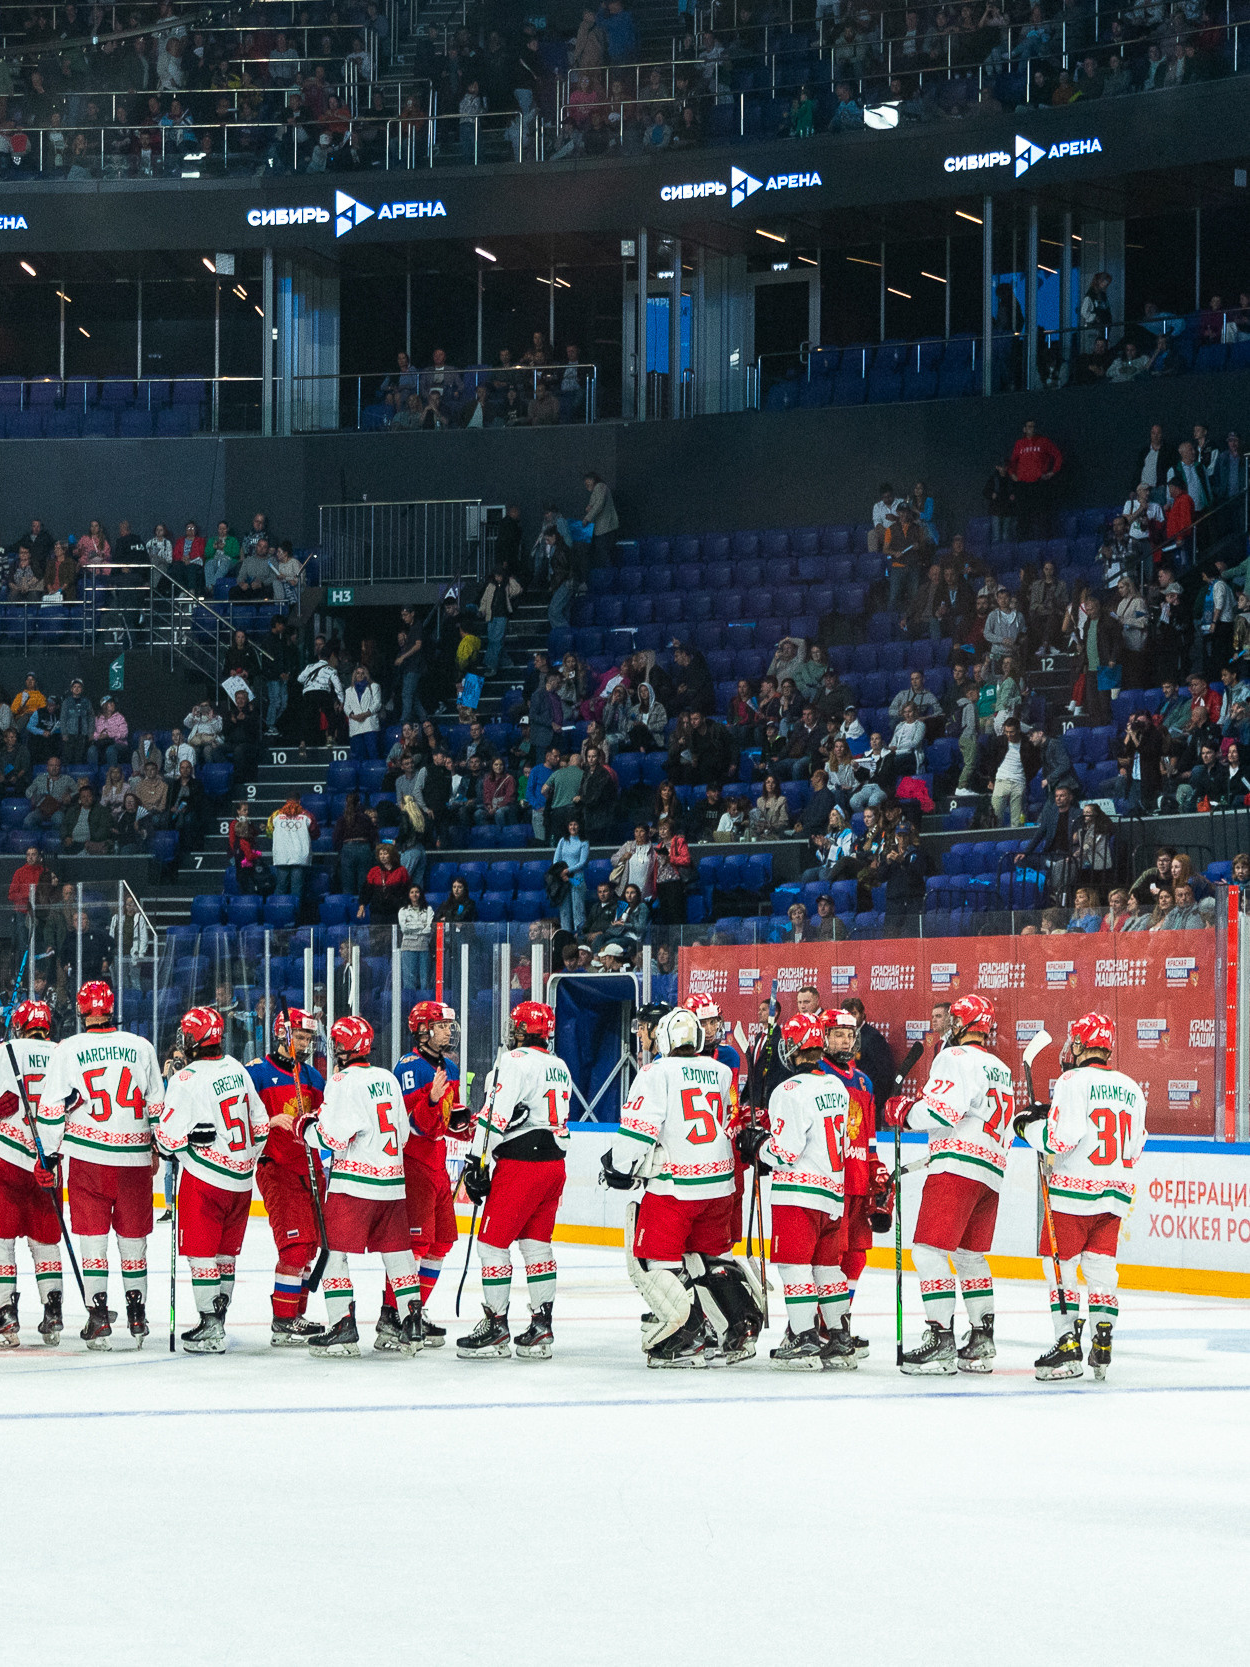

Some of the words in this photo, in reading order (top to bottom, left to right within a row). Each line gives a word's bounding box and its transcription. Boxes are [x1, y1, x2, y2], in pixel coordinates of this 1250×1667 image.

[943, 151, 1011, 173] СИБИРЬ
[1048, 138, 1102, 159] АРЕНА
[660, 181, 727, 201] СИБИРЬ
[765, 171, 822, 191] АРЕНА
[247, 207, 330, 226] СИБИРЬ
[377, 201, 447, 219] АРЕНА
[332, 590, 352, 602] H3
[1040, 658, 1054, 671] 12
[272, 752, 287, 764] 10
[332, 751, 348, 762] 10
[246, 785, 257, 797] 9
[219, 822, 229, 835] 8
[195, 856, 204, 868] 7
[981, 1013, 991, 1022] 27
[810, 1028, 821, 1037] 13
[1099, 1029, 1110, 1037] 30
[28, 1054, 50, 1068] NEV
[77, 1046, 137, 1067] MARCHENKO
[82, 1066, 146, 1122] 54
[931, 1079, 955, 1095] 27
[219, 1092, 255, 1152] 51
[680, 1087, 724, 1146] 50
[983, 1088, 1014, 1144] 27
[376, 1102, 399, 1157] 5
[1088, 1108, 1134, 1169] 30
[1149, 1178, 1250, 1212] ФЕДЕРАЦИ
[1149, 1213, 1221, 1242] ХОККЕЯ
